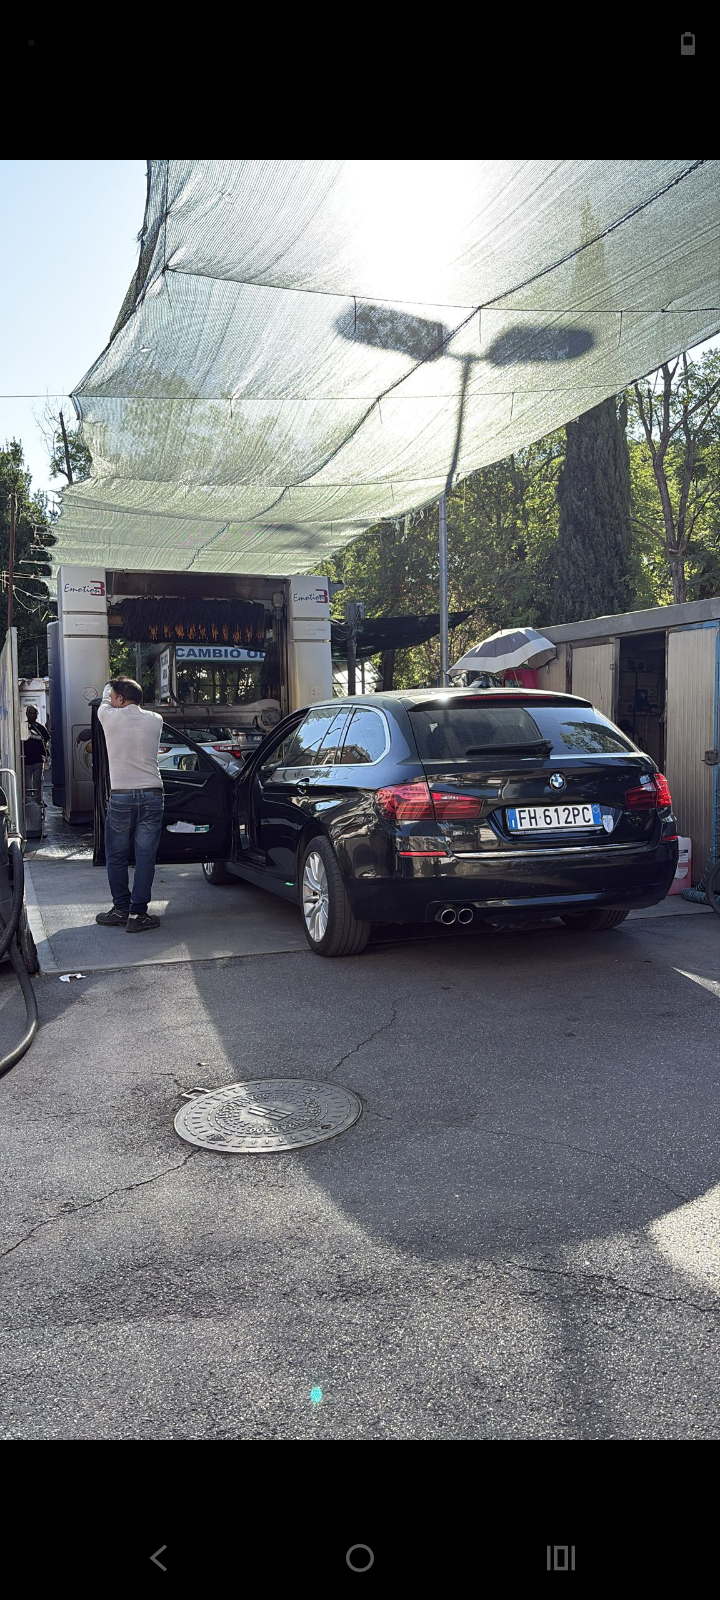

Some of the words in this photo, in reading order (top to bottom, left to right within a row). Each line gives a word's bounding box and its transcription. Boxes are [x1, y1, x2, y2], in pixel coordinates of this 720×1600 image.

[64, 582, 101, 595] Emotion
[90, 580, 105, 596] 3
[315, 588, 328, 603] 3
[175, 647, 242, 659] CAMBIO
[518, 809, 538, 827] FH
[543, 806, 591, 826] 612PC
